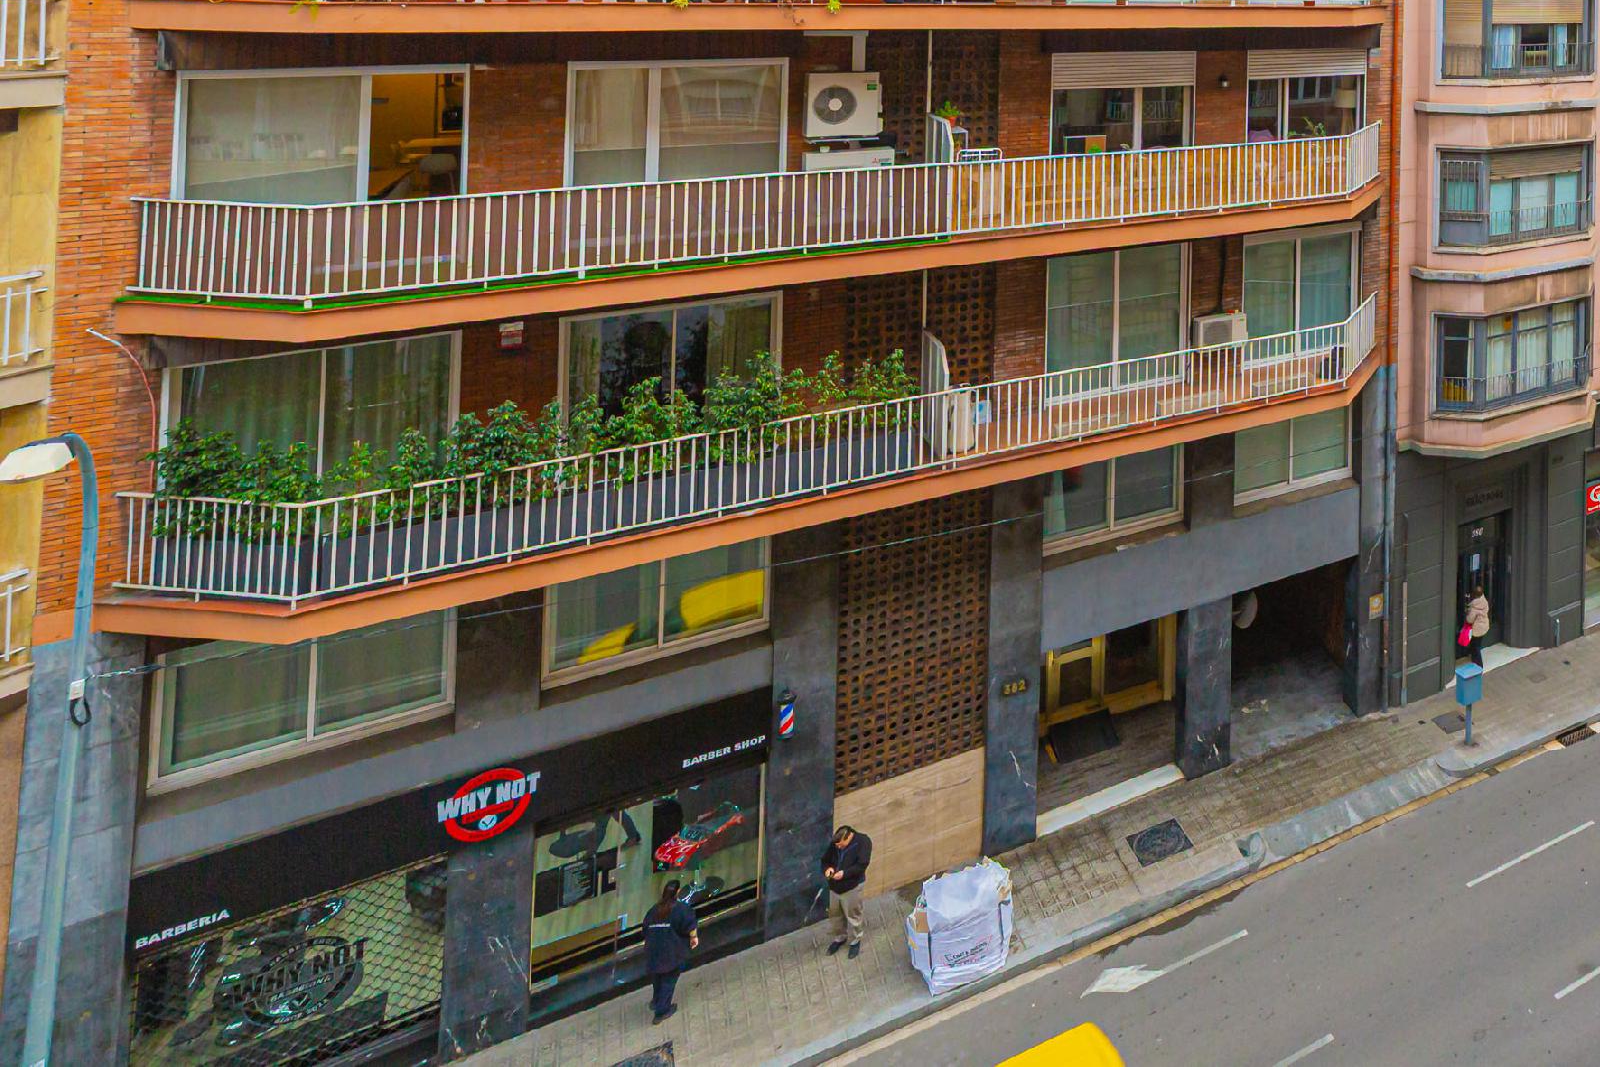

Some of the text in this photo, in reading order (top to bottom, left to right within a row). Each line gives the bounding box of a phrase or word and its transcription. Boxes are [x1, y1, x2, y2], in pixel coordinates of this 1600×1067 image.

[682, 735, 766, 768] BARBER SHOP
[437, 787, 492, 823] WHY
[496, 771, 541, 804] NOT
[135, 909, 230, 949] BARBERIA
